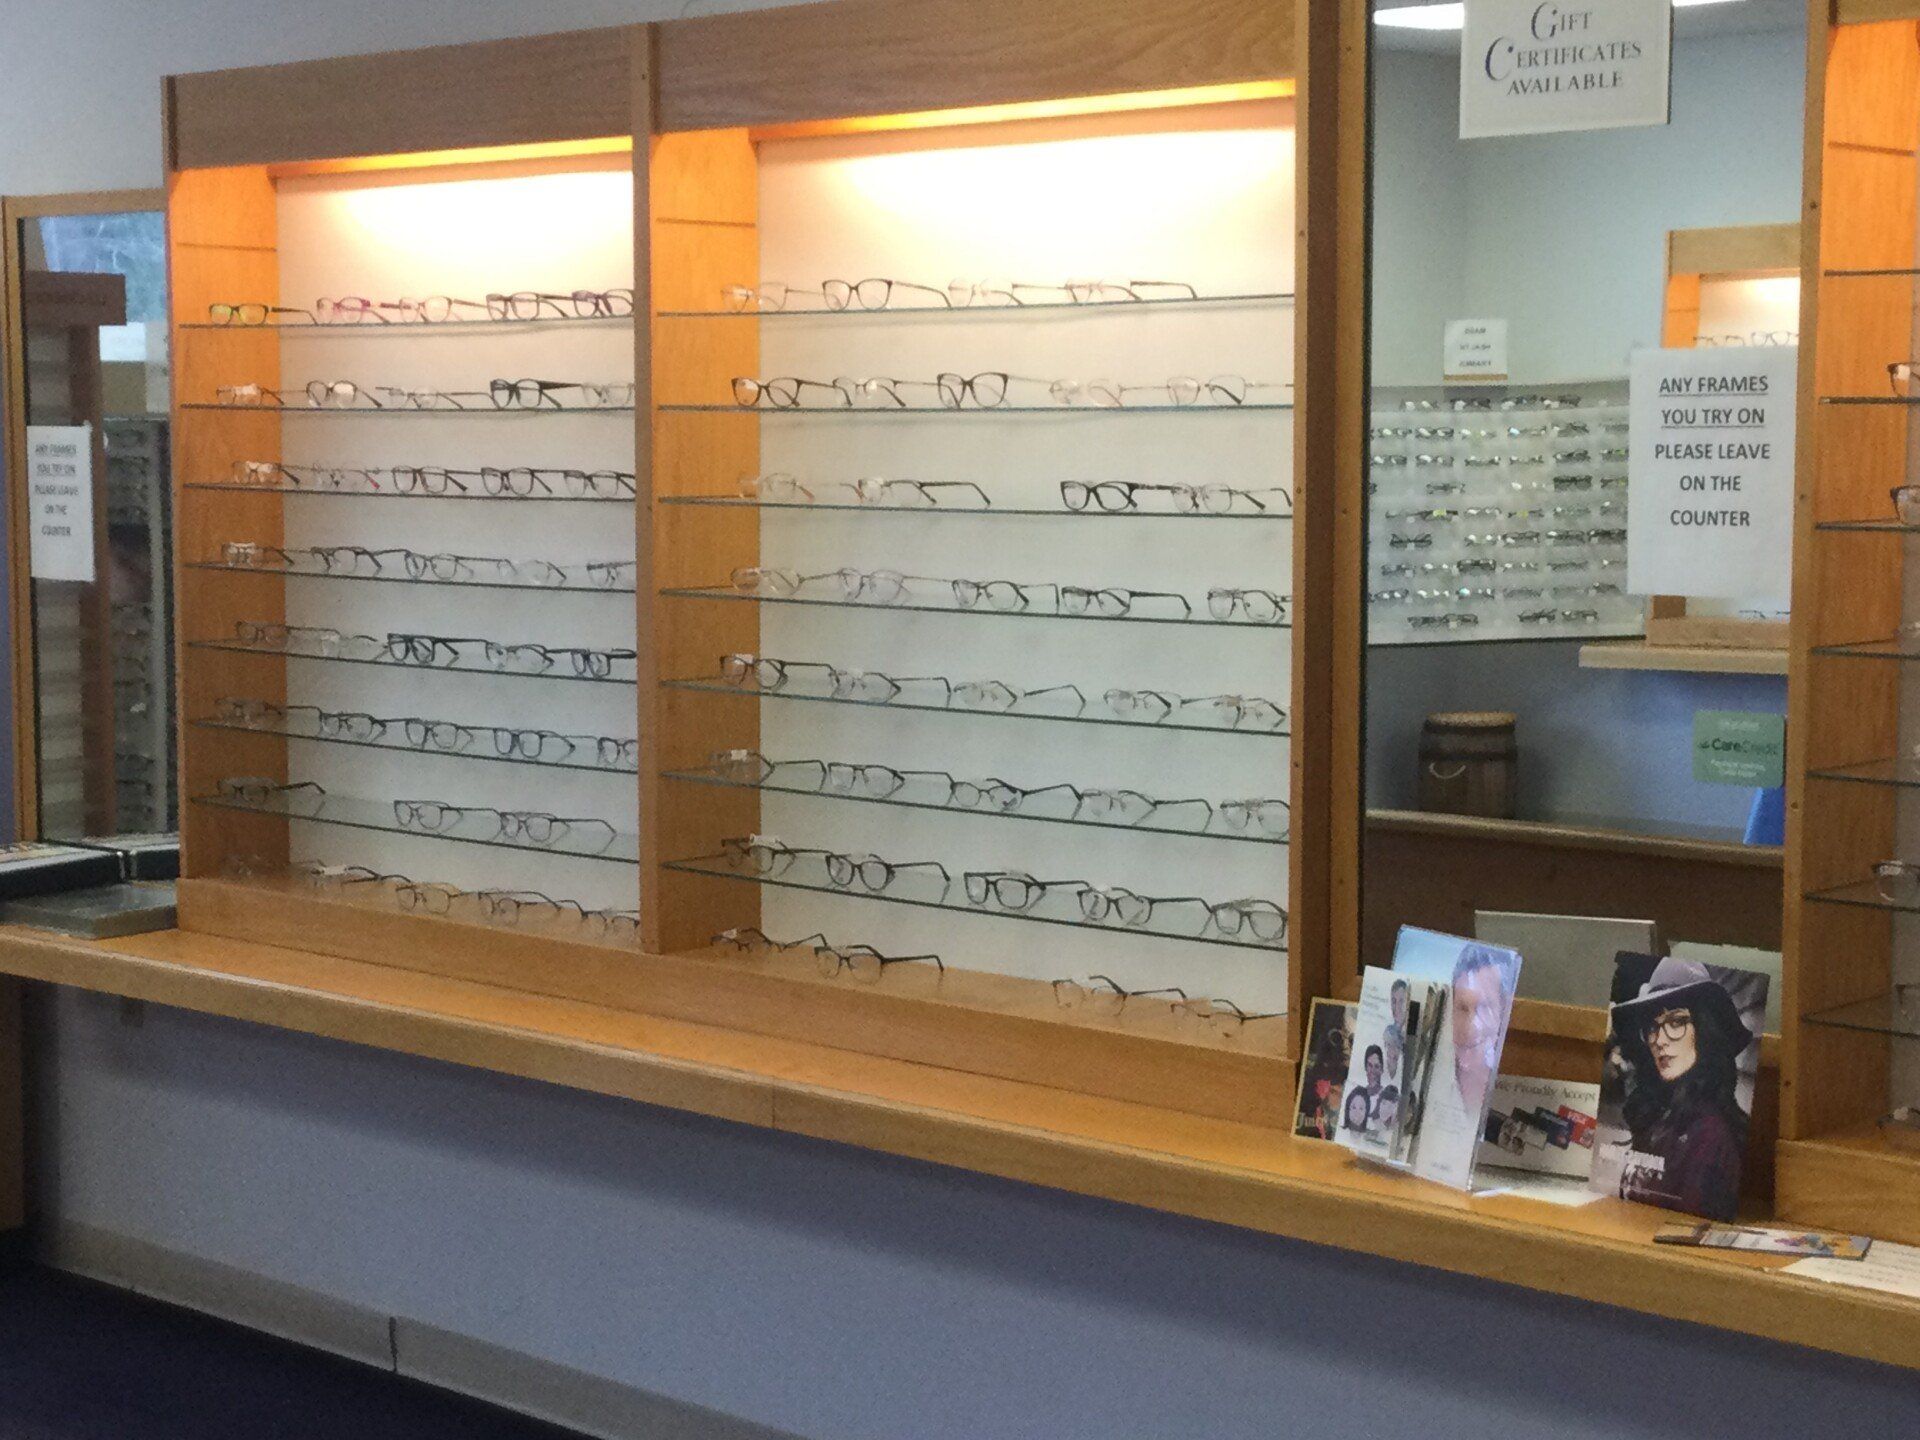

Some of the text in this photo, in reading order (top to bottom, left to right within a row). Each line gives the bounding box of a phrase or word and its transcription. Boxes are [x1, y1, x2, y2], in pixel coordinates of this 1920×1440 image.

[1530, 1, 1593, 41] GIFT
[1485, 36, 1642, 81] CERTIFICATES
[1506, 71, 1625, 96] AVAILABLE
[1659, 375, 1769, 393] ANY FRAMES
[1661, 408, 1765, 425] YOU TRY ON
[1654, 443, 1771, 460] PLEASE LEAVE
[1680, 475, 1742, 491] ON THE
[1670, 510, 1751, 527] COUNTER
